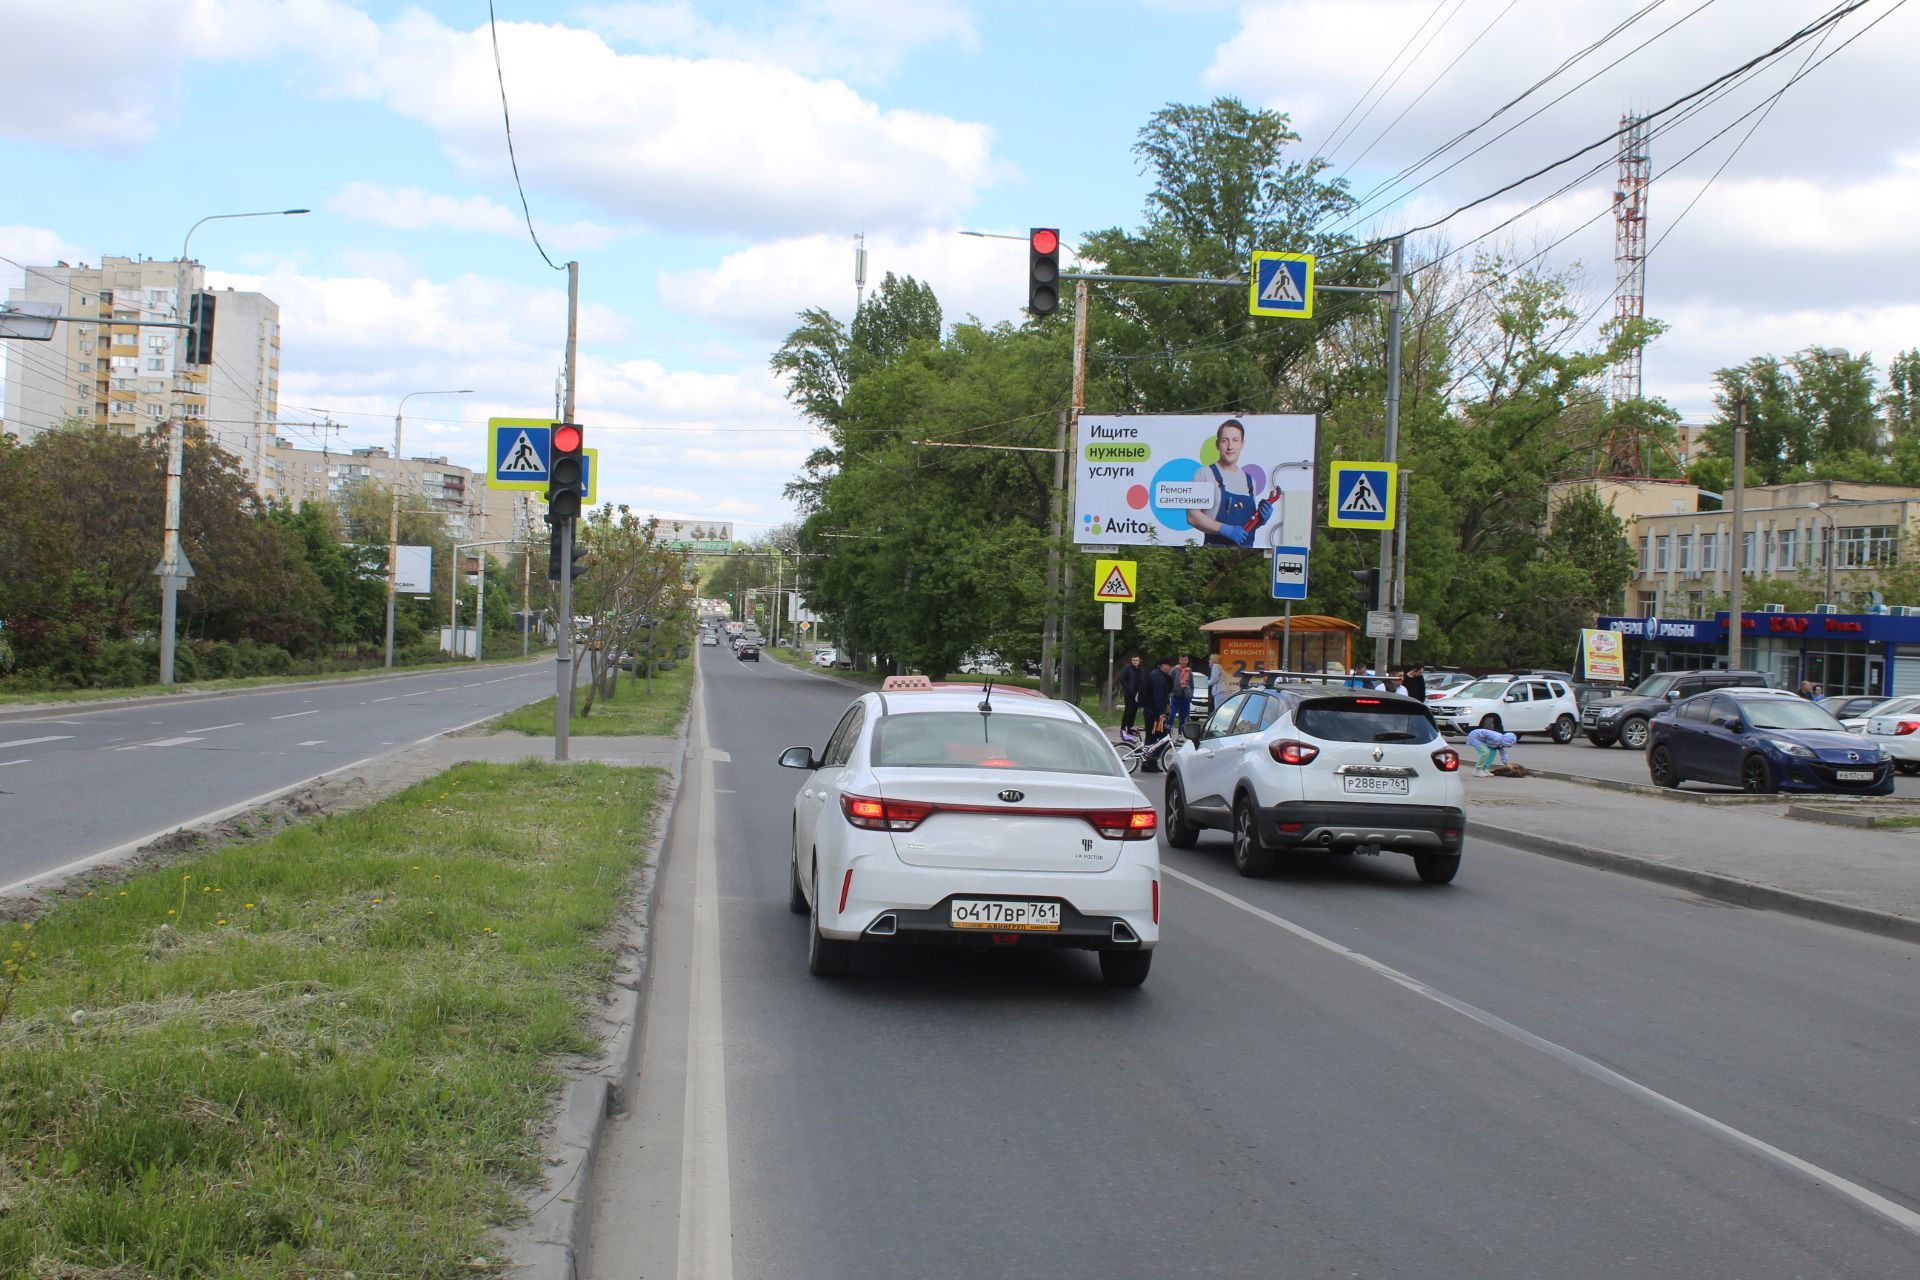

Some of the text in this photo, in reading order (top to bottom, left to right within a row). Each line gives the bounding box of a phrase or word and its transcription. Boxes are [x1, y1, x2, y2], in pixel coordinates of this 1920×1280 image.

[1091, 425, 1138, 440] Ищите
[1089, 447, 1145, 460] нужные
[1089, 466, 1134, 479] услуги
[1160, 485, 1193, 494] Ремонт
[1160, 496, 1210, 504] сантехники
[1105, 517, 1149, 534] Avito
[1002, 791, 1020, 800] KIA
